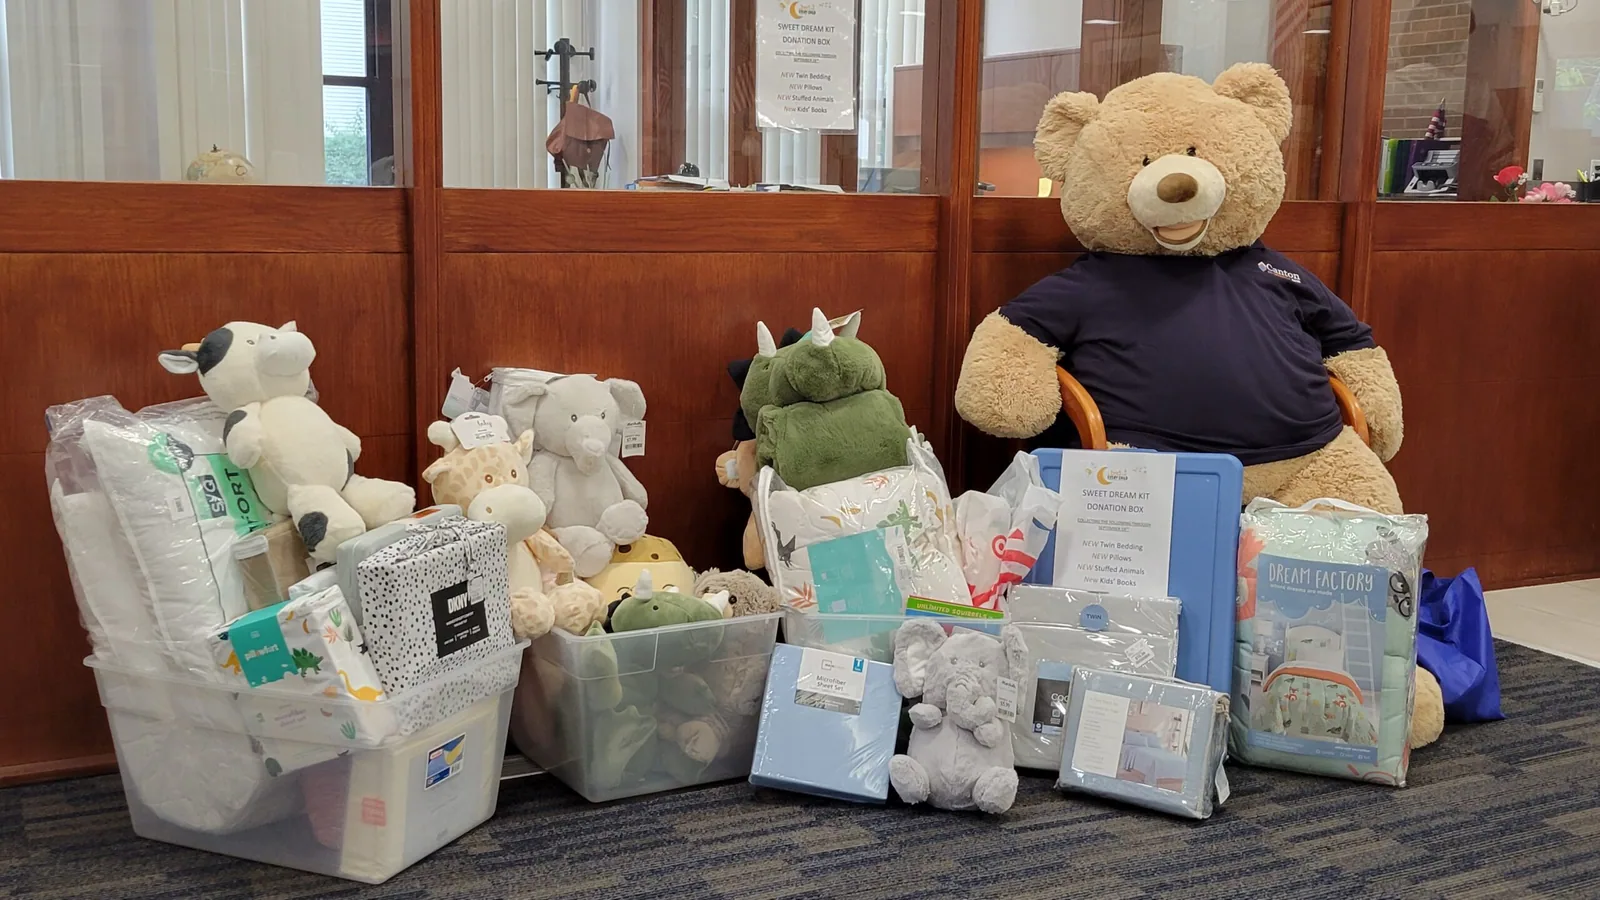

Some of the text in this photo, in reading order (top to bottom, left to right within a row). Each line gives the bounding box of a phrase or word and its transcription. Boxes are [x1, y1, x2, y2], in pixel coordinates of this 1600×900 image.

[778, 23, 800, 32] SWEET
[801, 25, 824, 33] DREAM
[783, 36, 831, 46] DONATION BOX
[809, 73, 831, 81] Bedding
[1266, 263, 1301, 280] Canton
[1082, 489, 1150, 500] SWEET DREAM KIT
[225, 468, 260, 533] FORT
[1087, 503, 1144, 513] DONATION BOX
[1100, 541, 1115, 549] Twin
[1117, 542, 1143, 551] Bedding
[1092, 552, 1132, 562] NEW Pillows
[1077, 563, 1145, 575] NEW Stuffed Animals
[1117, 578, 1136, 587] Books
[1269, 562, 1373, 592] DREAM FACTORY
[447, 592, 468, 614] DKNY
[916, 603, 987, 619] UNLIMITED SQUIRRELS
[816, 675, 847, 686] Microfiber
